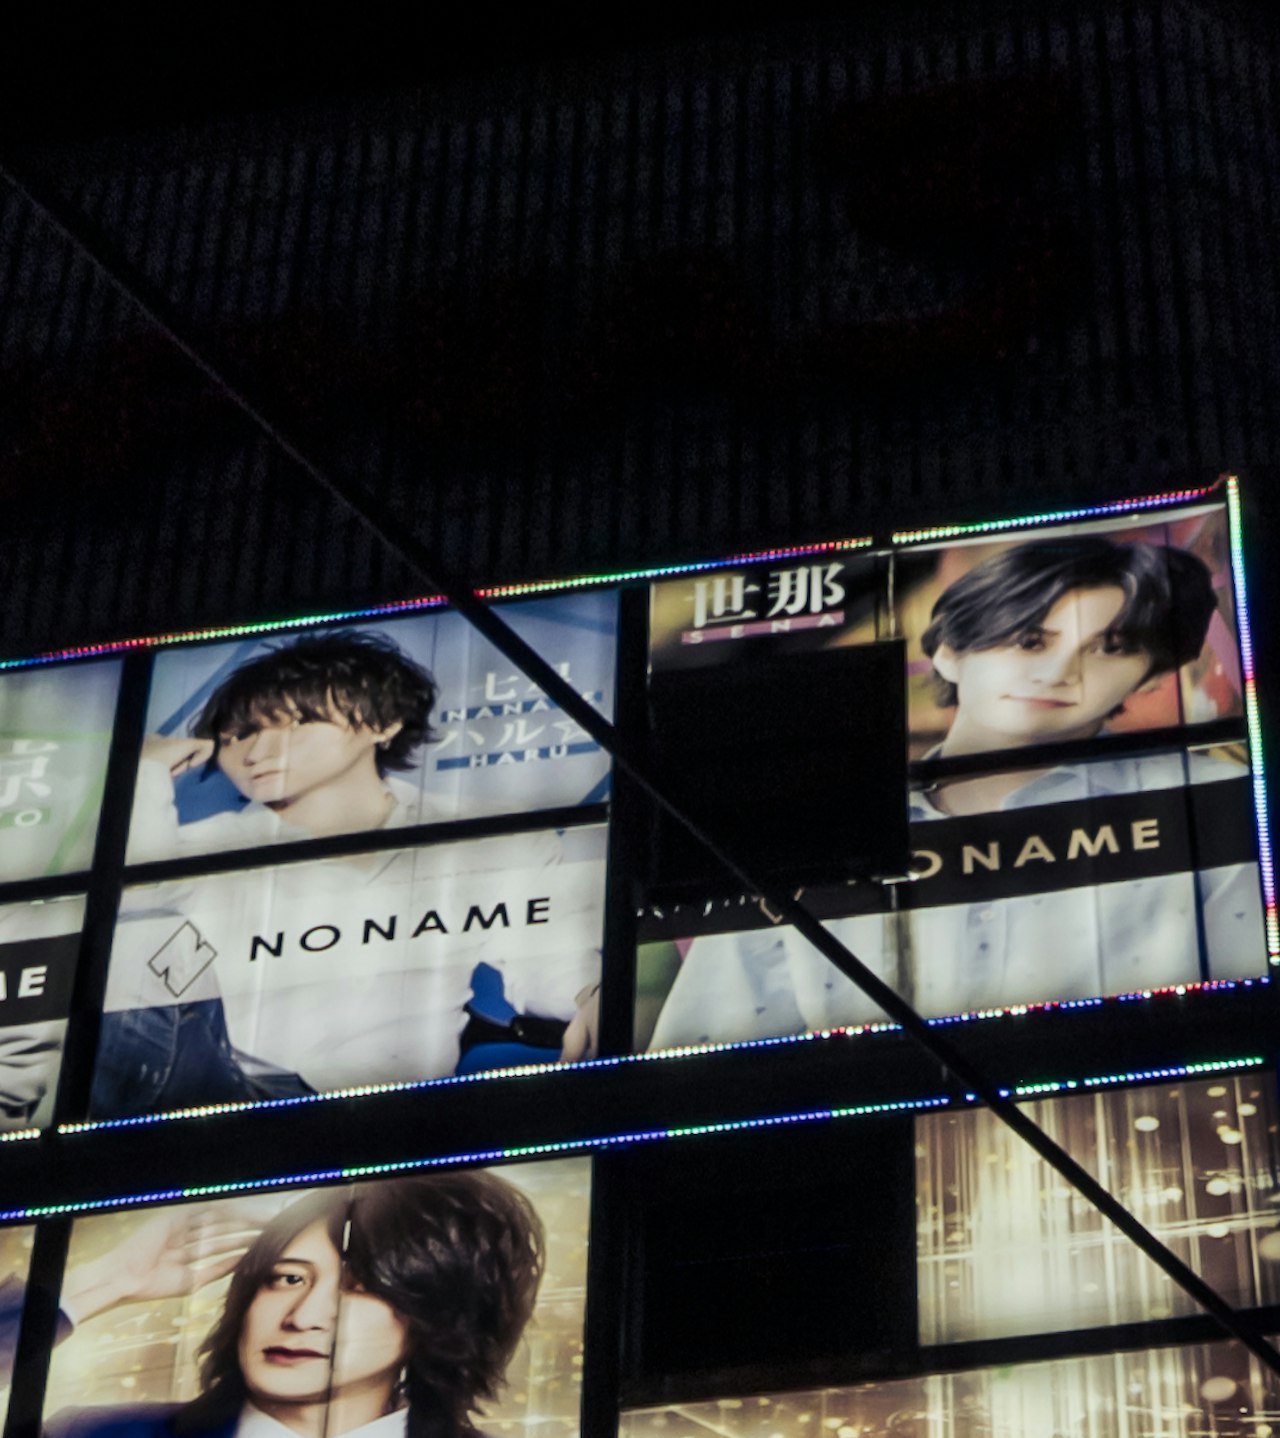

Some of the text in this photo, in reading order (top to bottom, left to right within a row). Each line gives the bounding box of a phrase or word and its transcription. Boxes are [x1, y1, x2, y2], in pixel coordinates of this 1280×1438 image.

[682, 562, 846, 630] 世那
[689, 614, 836, 644] SENA
[471, 744, 568, 768] HARU
[248, 896, 552, 962] NONAME
